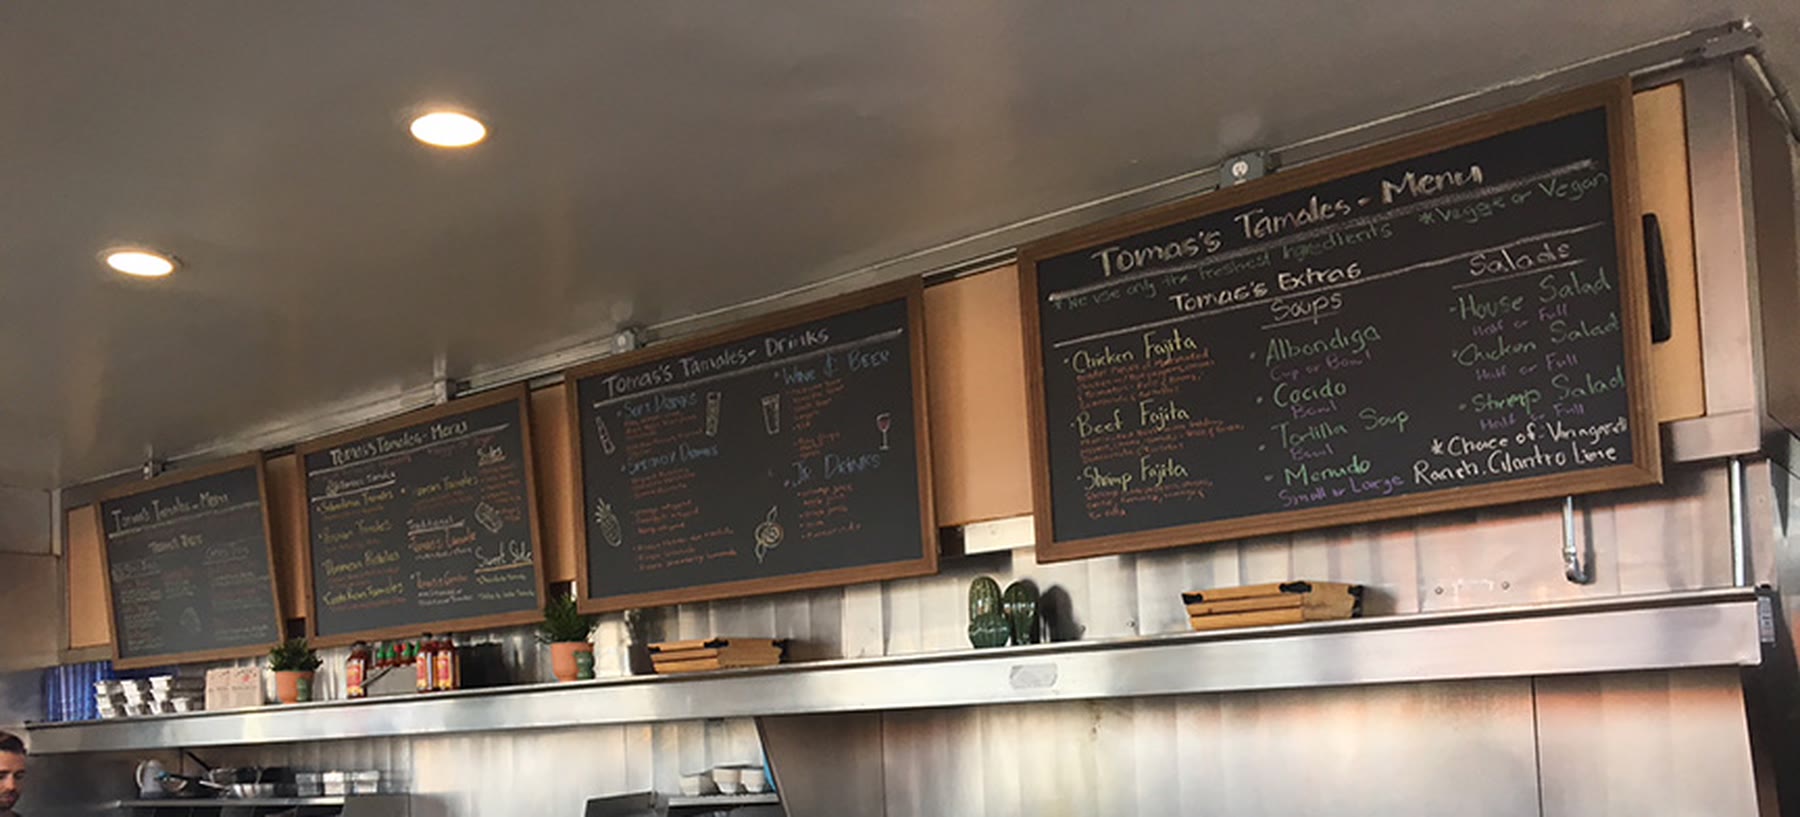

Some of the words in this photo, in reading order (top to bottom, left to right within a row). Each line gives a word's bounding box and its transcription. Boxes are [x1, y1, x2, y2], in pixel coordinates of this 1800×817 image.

[1511, 189, 1533, 204] or
[1538, 171, 1609, 201] Vegan
[1091, 230, 1222, 277] Tomas's
[1234, 193, 1351, 240] Tamales
[1380, 164, 1484, 204] Menu
[1468, 241, 1571, 277] Salads
[1126, 278, 1157, 299] only
[1168, 281, 1269, 312] Tomas's
[1277, 262, 1362, 292] Extras
[1539, 266, 1612, 303] Salad
[1270, 292, 1344, 325] Soups
[1538, 303, 1569, 322] Full
[1549, 311, 1620, 344] Salad
[1072, 346, 1134, 374] Chicken
[1143, 328, 1198, 360] Fajita
[1266, 325, 1381, 367] Albondiga
[1270, 366, 1300, 381] Cup
[1305, 364, 1321, 374] or
[1326, 349, 1372, 370] Bowl
[1519, 364, 1538, 376] or
[1544, 352, 1578, 371] Full
[1551, 364, 1626, 401] Salad
[1076, 408, 1124, 438] Beef
[1139, 398, 1191, 430] Fajita
[1290, 400, 1337, 420] Bowl
[1552, 402, 1585, 418] Full
[1270, 421, 1349, 449] Tortilla
[1358, 407, 1409, 433] Soup
[1290, 443, 1334, 461] Bowl
[1571, 441, 1617, 465] Lime
[1083, 464, 1134, 492] Shrimp
[1140, 454, 1190, 487] Fajita
[1279, 486, 1327, 507] Small
[1349, 475, 1404, 495] Large
